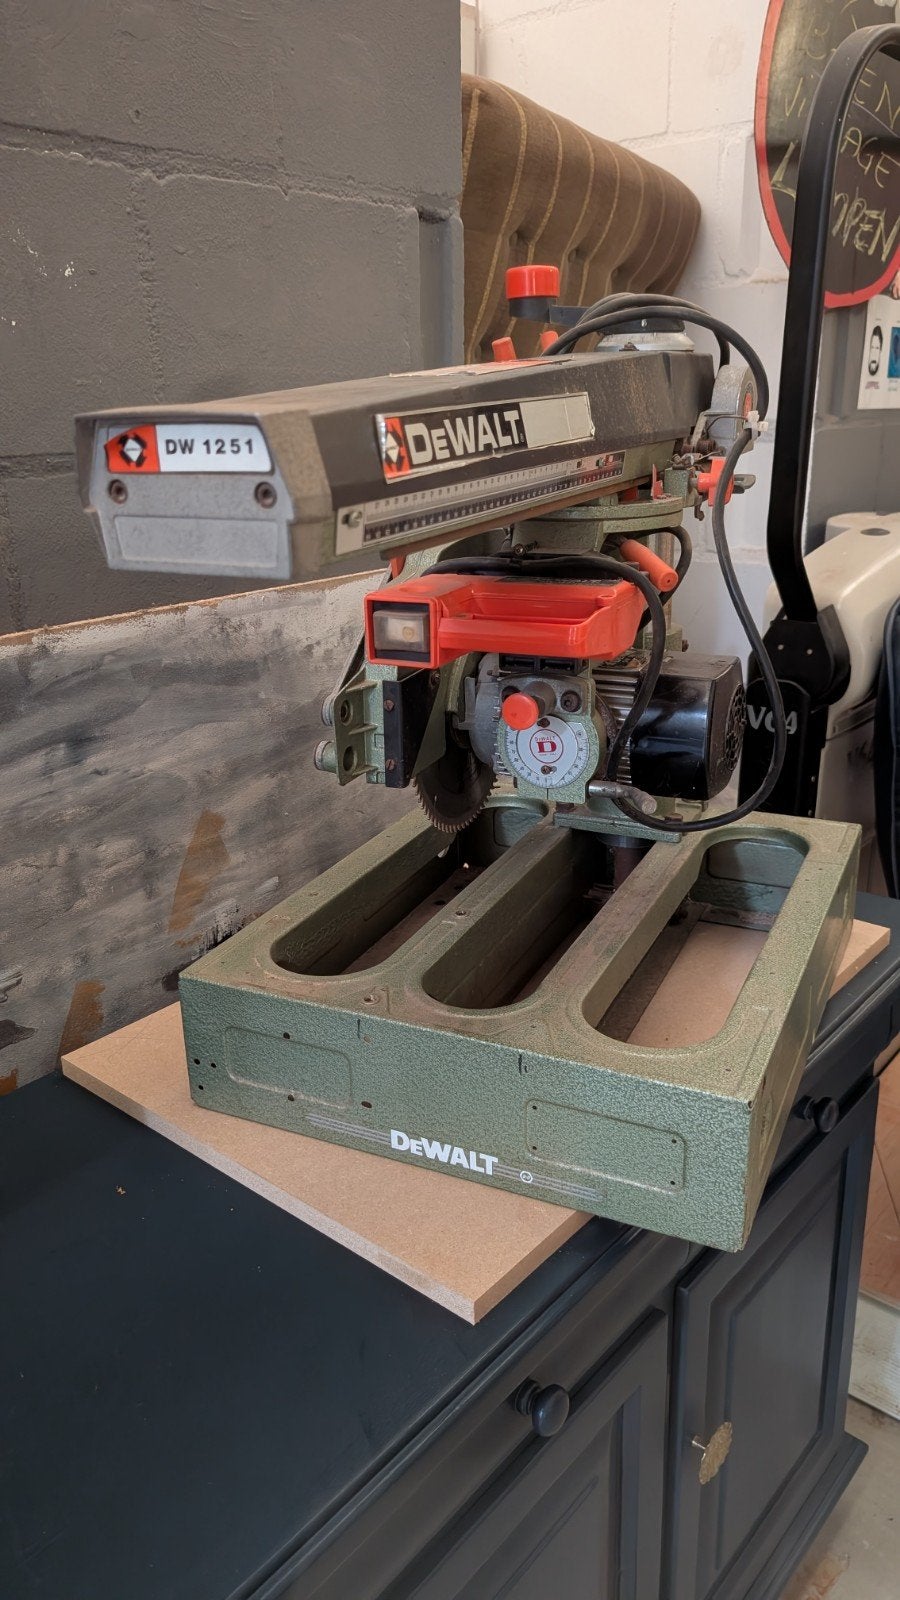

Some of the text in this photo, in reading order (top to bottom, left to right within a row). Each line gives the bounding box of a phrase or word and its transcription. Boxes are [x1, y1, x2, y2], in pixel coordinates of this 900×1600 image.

[165, 438, 254, 455] DW 1251
[405, 410, 521, 465] DEWALT
[390, 1129, 498, 1175] DEWALT
